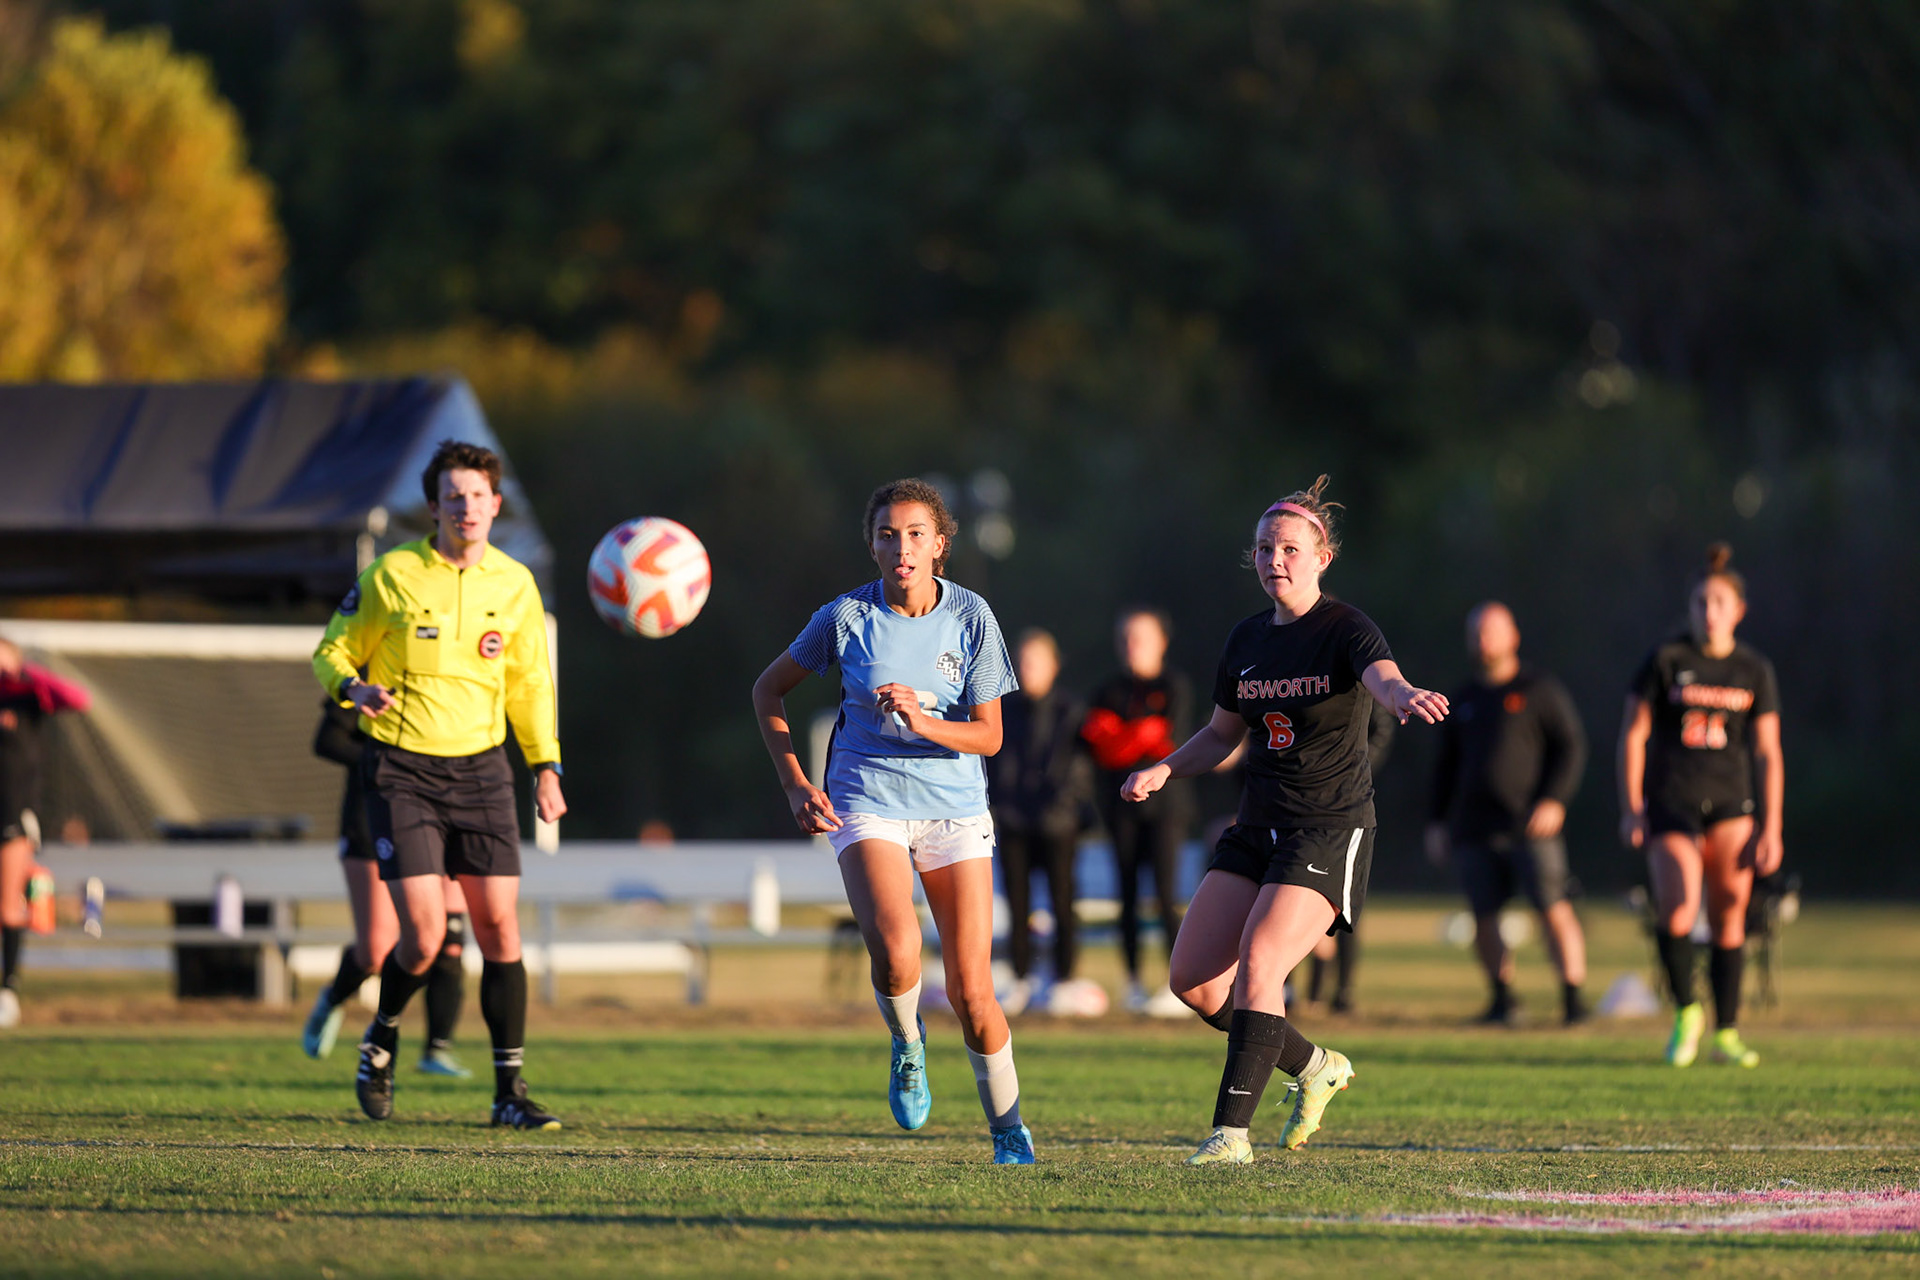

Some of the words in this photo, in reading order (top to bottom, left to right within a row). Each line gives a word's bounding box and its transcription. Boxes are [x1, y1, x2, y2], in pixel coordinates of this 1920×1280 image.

[936, 655, 961, 682] SBA
[1237, 675, 1330, 699] NSWORTH
[1262, 711, 1295, 750] 6
